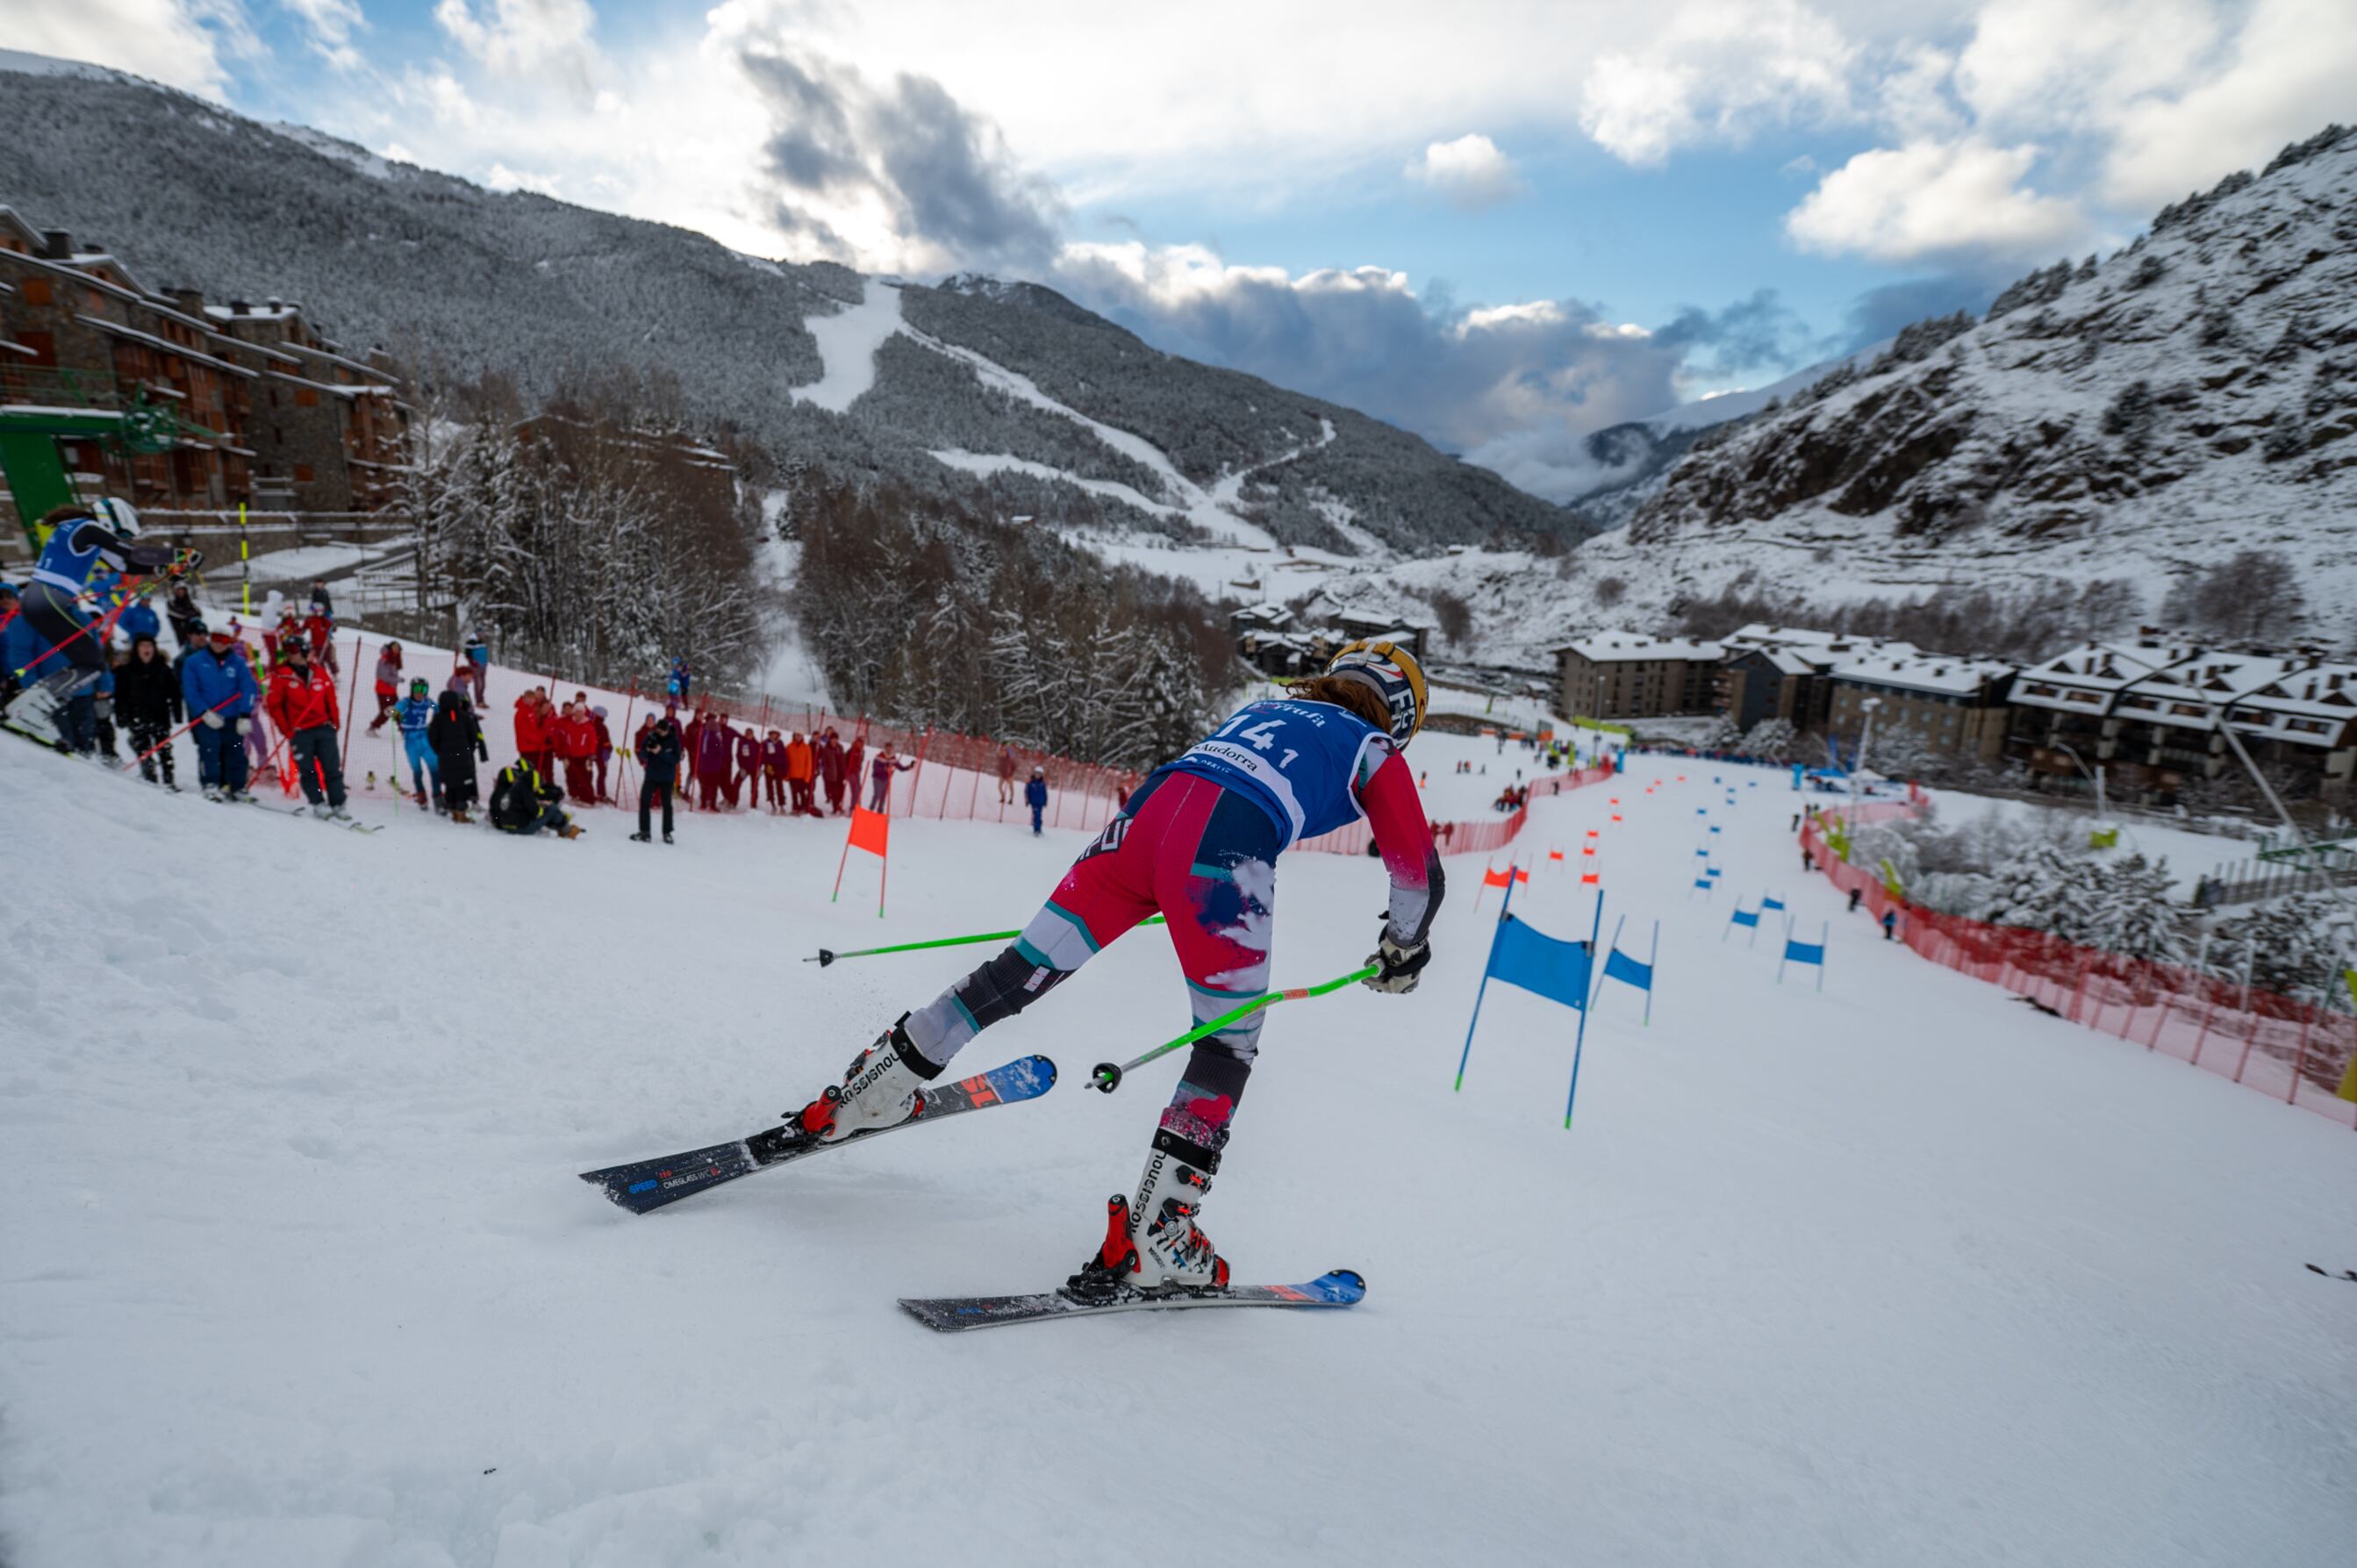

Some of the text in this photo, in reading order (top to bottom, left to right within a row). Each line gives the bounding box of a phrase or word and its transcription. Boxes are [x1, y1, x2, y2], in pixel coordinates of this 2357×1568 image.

[1214, 713, 1287, 751] 14
[1197, 742, 1258, 772] Andorra
[1279, 748, 1300, 770] 1
